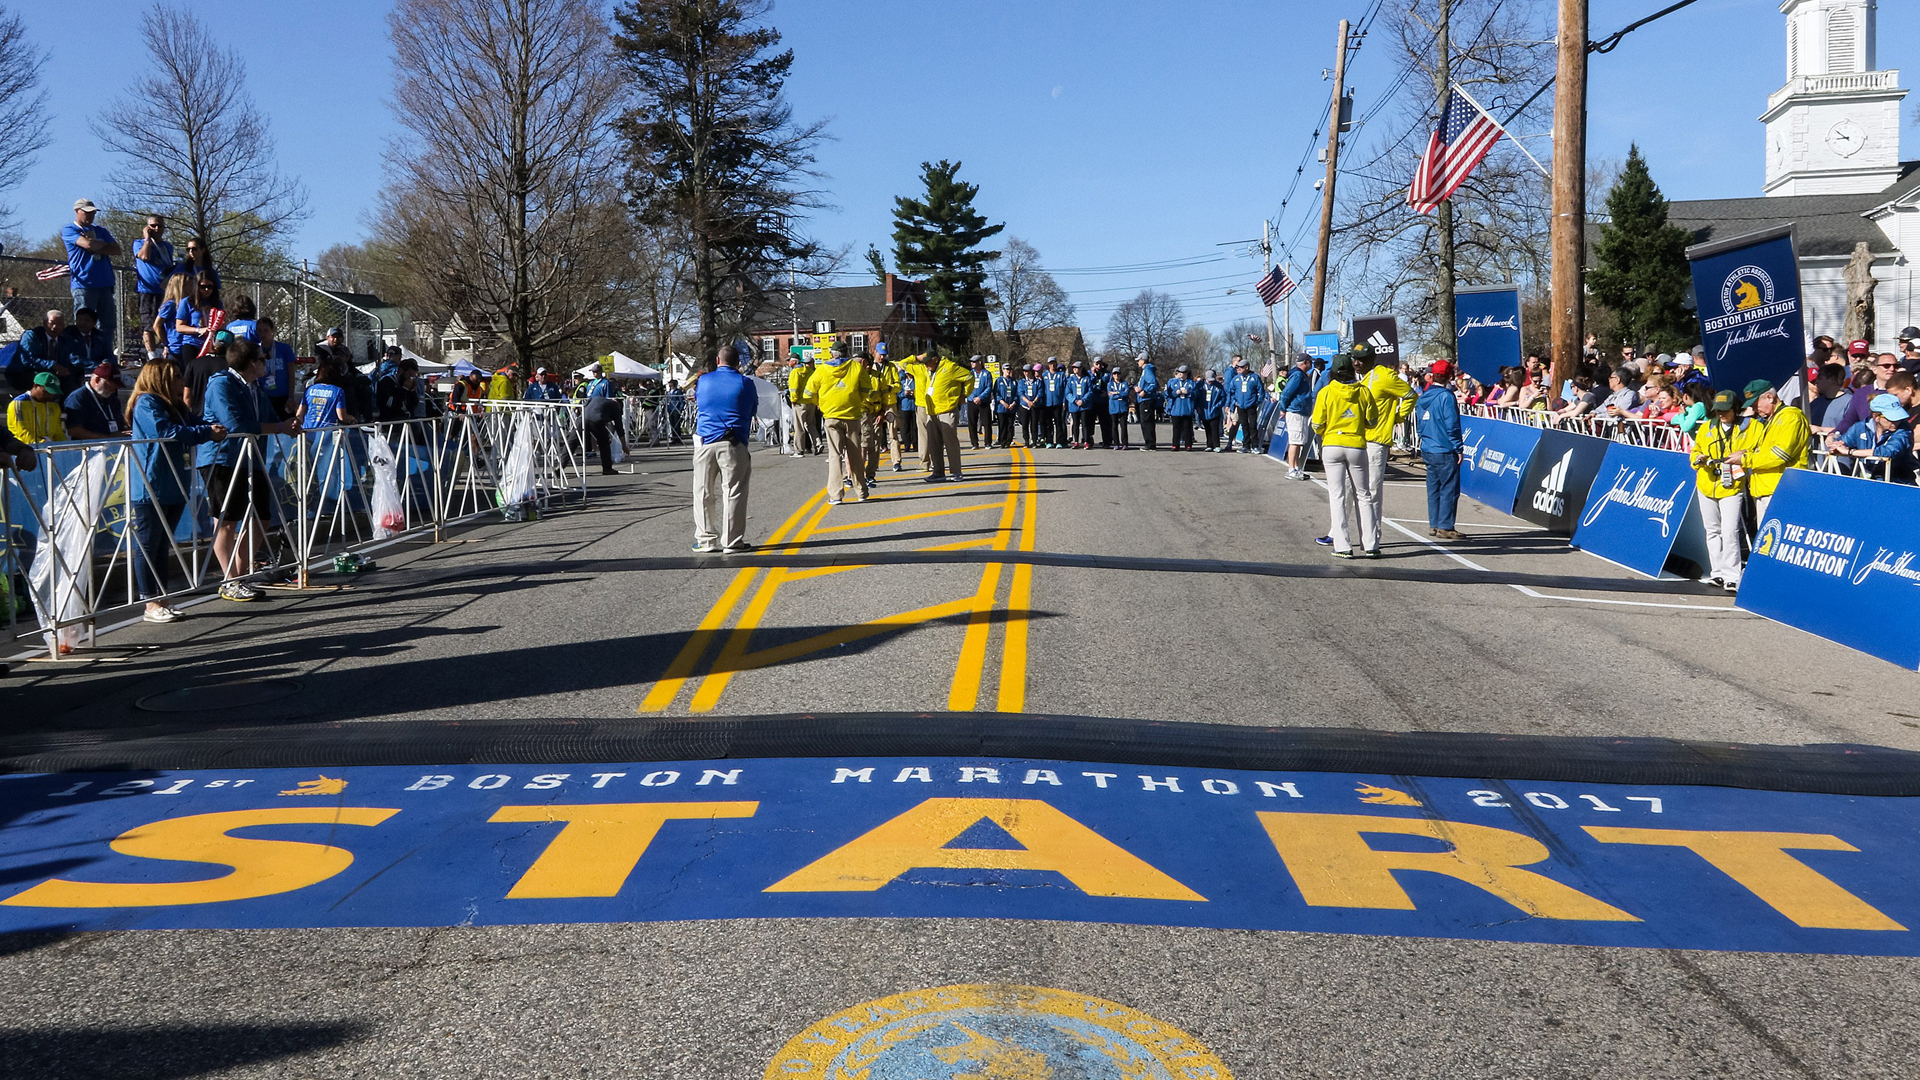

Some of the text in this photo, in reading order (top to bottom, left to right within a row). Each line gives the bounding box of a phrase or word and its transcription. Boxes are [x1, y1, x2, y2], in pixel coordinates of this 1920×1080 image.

[1723, 267, 1773, 311] BOSTON ATHLETIC ASSOCIATION
[1457, 315, 1518, 338] John Hancock
[1704, 300, 1796, 332] BOSTON MARATHON
[1374, 345, 1395, 354] das
[1716, 318, 1790, 361] John Hancock
[1532, 489, 1565, 518] adidas
[1583, 463, 1686, 538] John Hancock
[1783, 523, 1806, 543] THE
[1804, 528, 1856, 555] BOSTON
[1775, 542, 1849, 578] MARATHON
[1852, 546, 1895, 586] John
[404, 769, 743, 791] BOSTON
[831, 767, 1304, 798] MARATHON
[1466, 789, 1663, 813] 2017
[1, 797, 1910, 931] START
[801, 992, 960, 1046] YEARS
[1084, 1001, 1218, 1080] WOME
